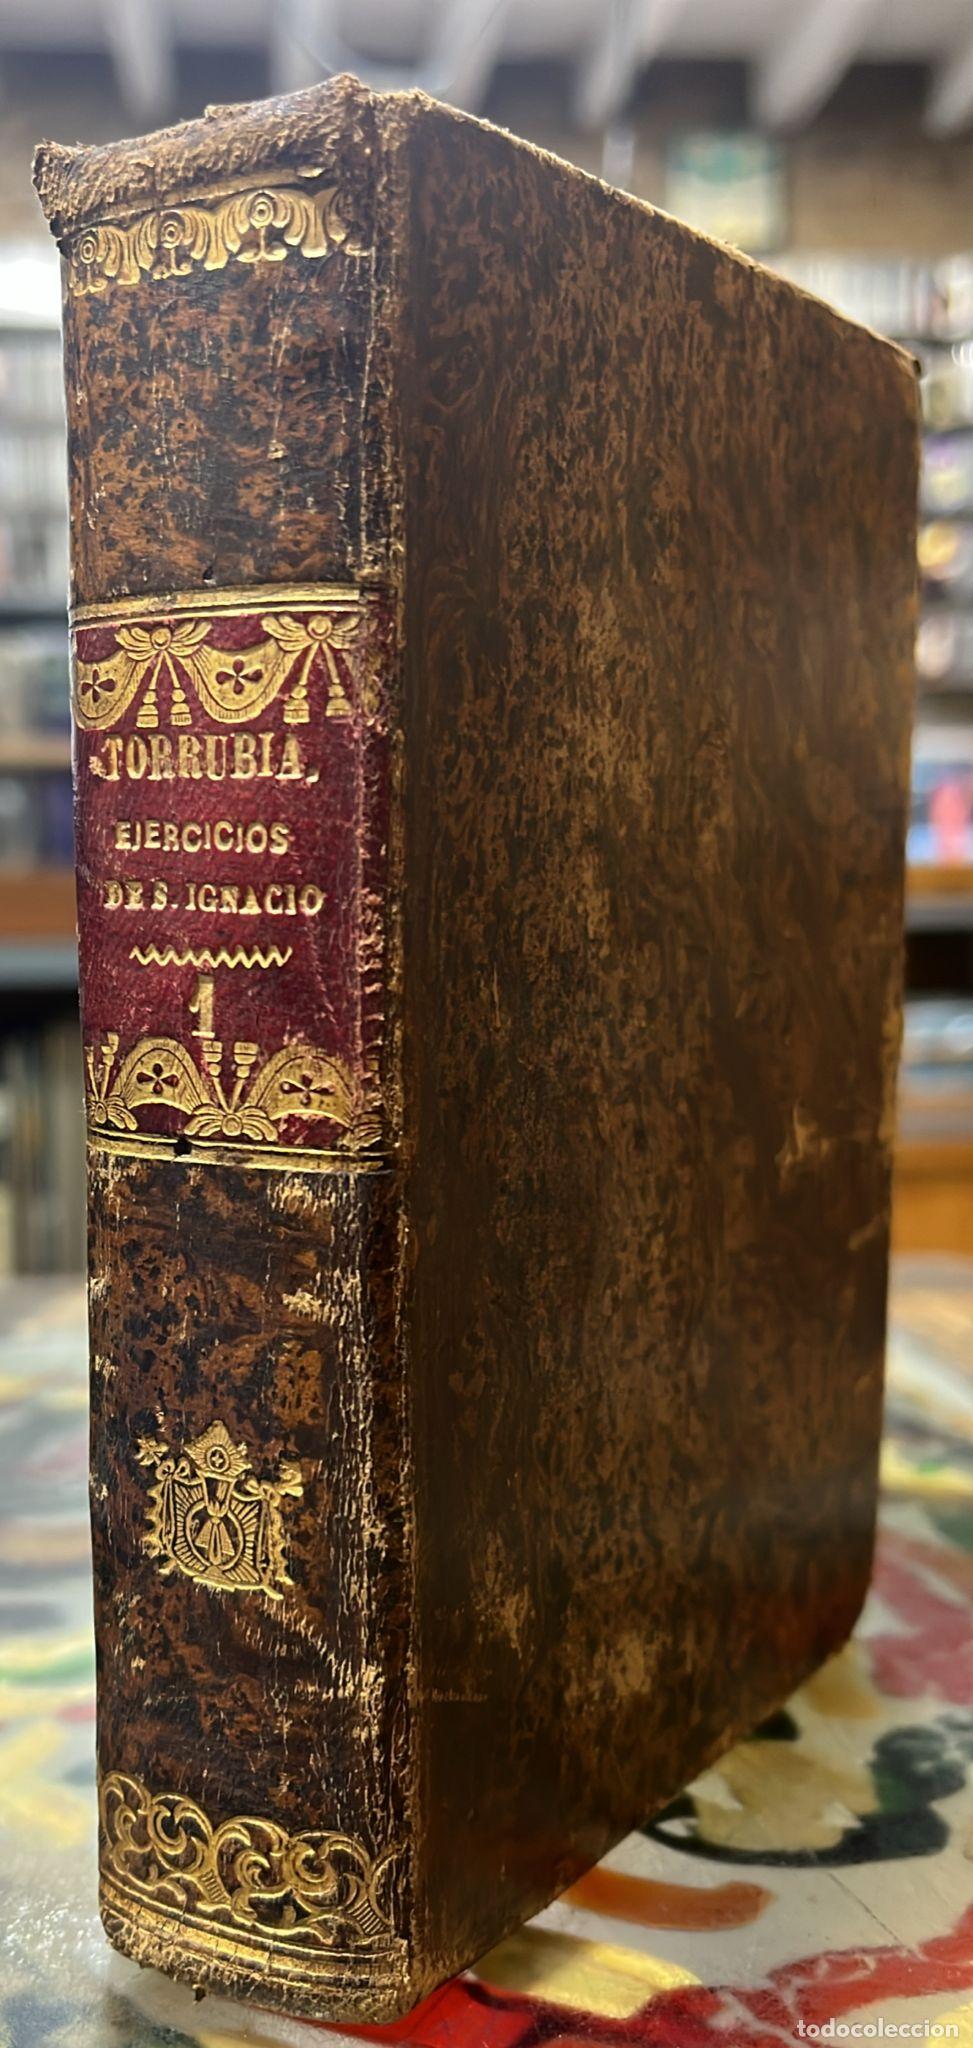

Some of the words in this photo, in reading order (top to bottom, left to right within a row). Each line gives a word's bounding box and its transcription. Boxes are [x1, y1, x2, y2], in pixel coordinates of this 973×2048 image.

[115, 819, 292, 855] EJERCICIOS
[103, 880, 145, 911] DE
[150, 881, 179, 911] S.
[184, 883, 327, 917] IGNACIO
[189, 973, 216, 1039] 1
